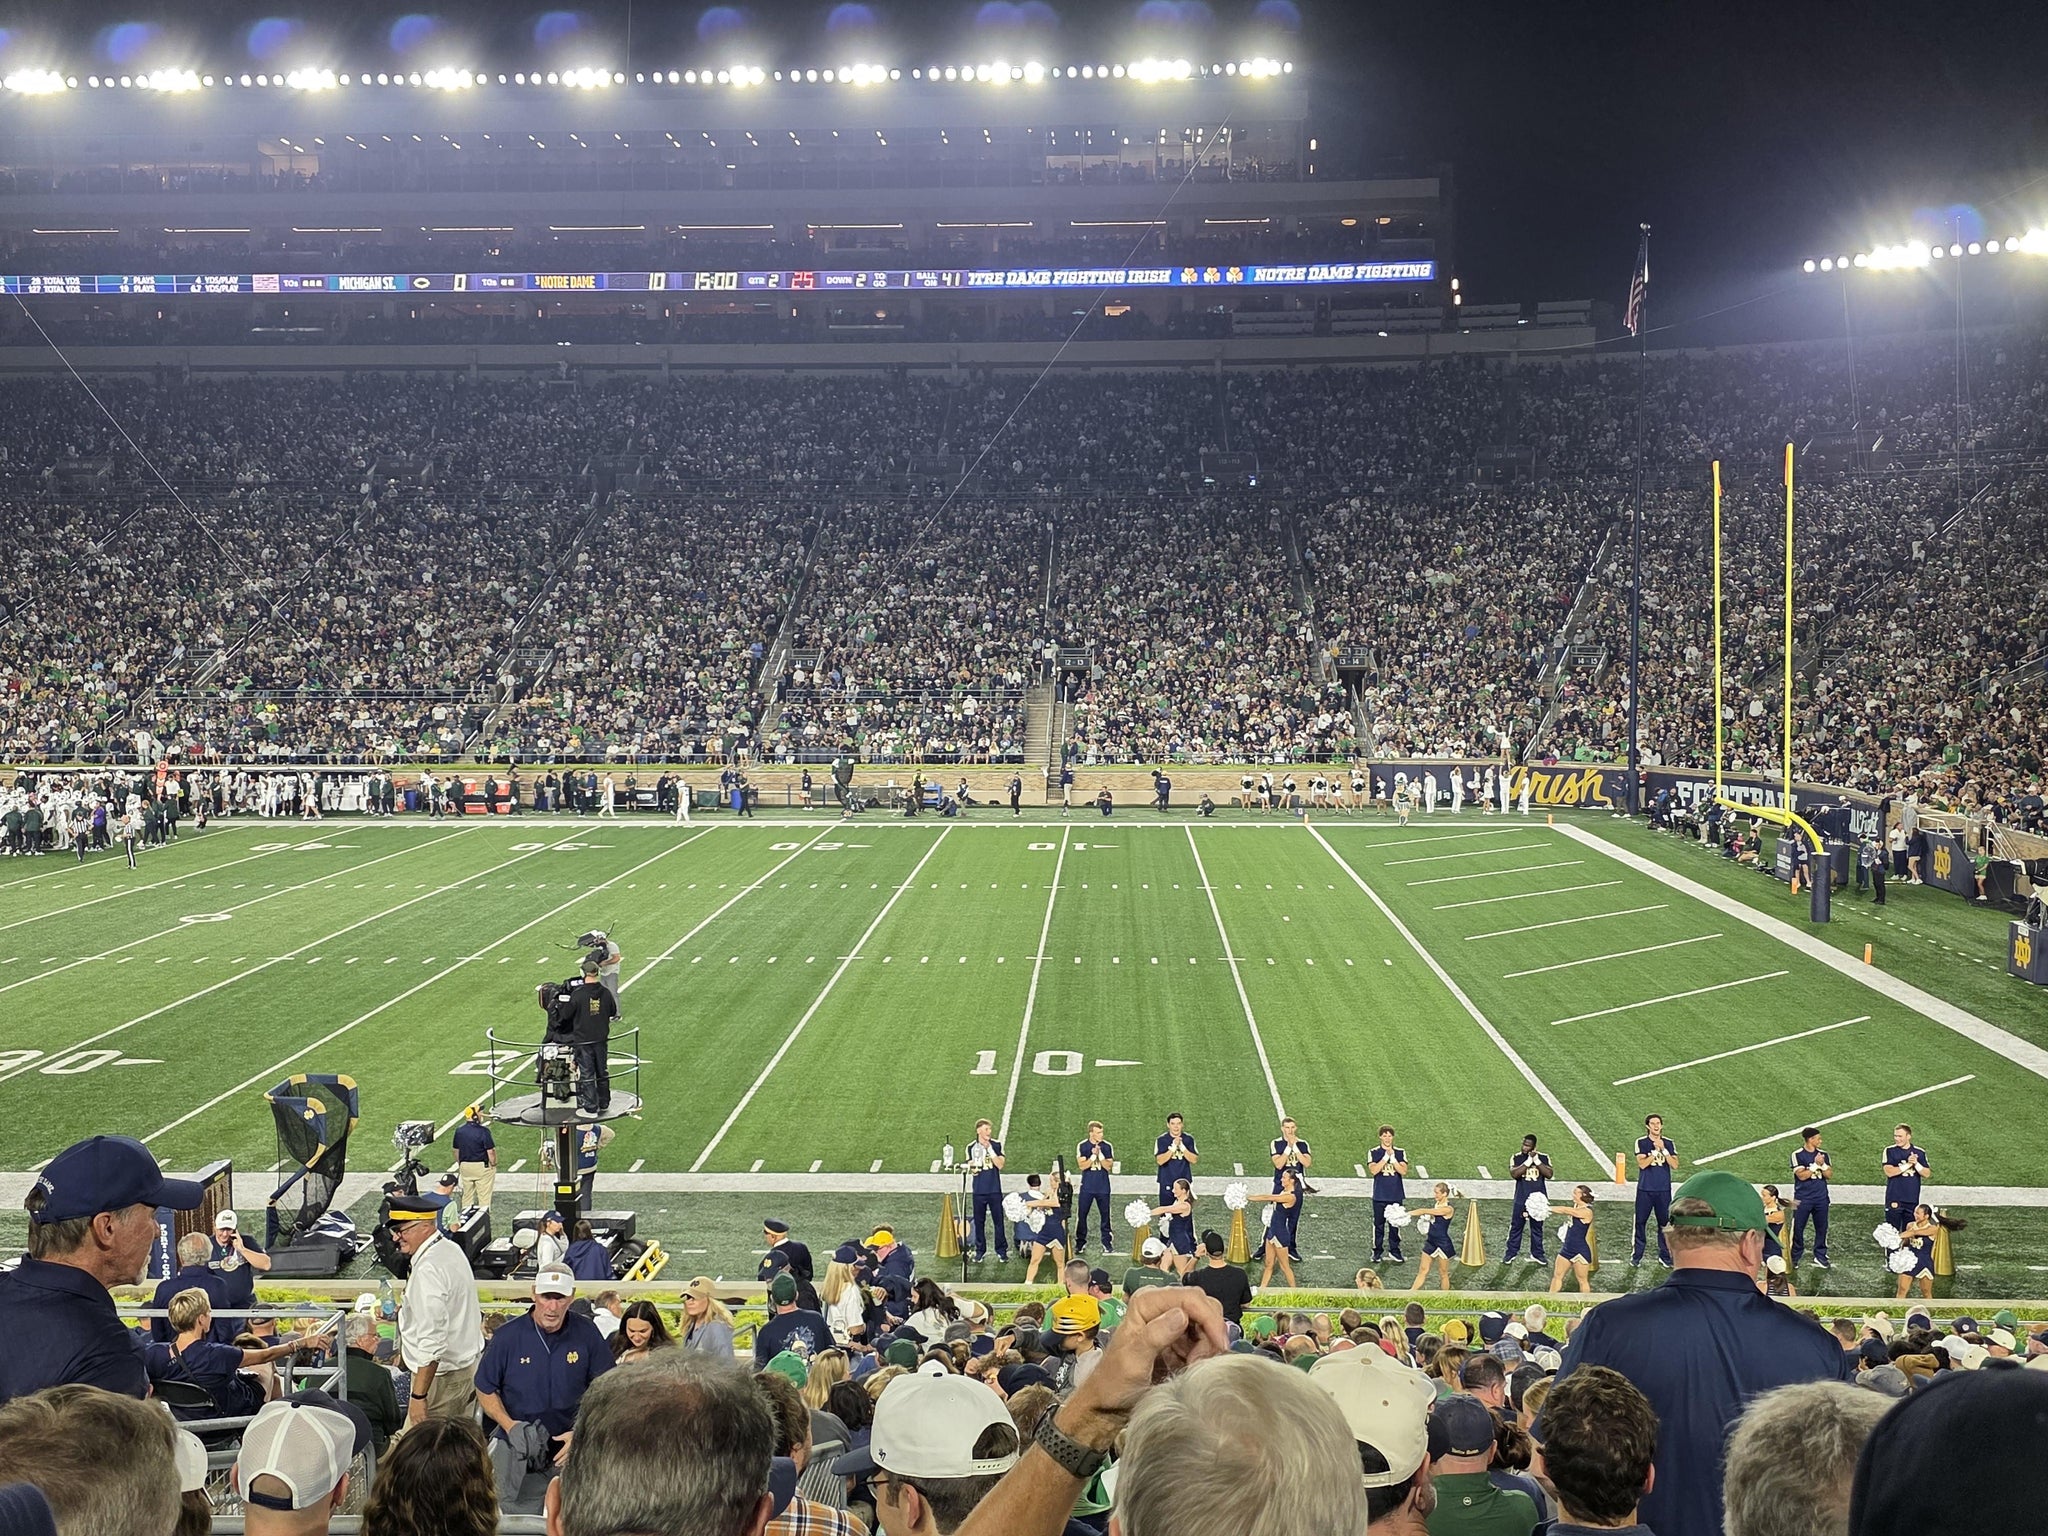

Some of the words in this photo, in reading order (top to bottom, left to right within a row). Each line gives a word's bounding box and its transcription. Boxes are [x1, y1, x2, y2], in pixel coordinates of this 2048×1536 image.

[826, 276, 852, 285] DOWN
[855, 273, 866, 287] 2
[874, 272, 886, 280] TO
[903, 273, 909, 287] 1
[916, 272, 937, 280] BALL
[942, 272, 960, 287] 41
[1006, 271, 1051, 285] DAME
[1052, 270, 1126, 285] FIGHTING
[1127, 269, 1171, 284] IRISH
[1254, 267, 1307, 282] NOTRE
[1307, 266, 1355, 281] DAME
[1355, 264, 1431, 280] FIGHTING
[43, 277, 65, 285] TOTAL
[66, 277, 80, 285] YDS
[133, 277, 155, 285] PLAYS
[339, 276, 382, 290] MICHIGAN
[383, 276, 397, 290] ST.
[541, 275, 569, 289] NOTRE
[570, 275, 595, 289] DAME
[649, 273, 666, 290] 10
[695, 273, 738, 290] 15:00
[748, 277, 765, 285] QTR
[768, 274, 779, 287] 2
[791, 272, 813, 289] 25
[873, 279, 886, 287] GO
[924, 279, 938, 287] ON
[43, 285, 65, 293] TOTAL
[66, 285, 80, 293] YDS
[133, 285, 155, 293] PLAYS
